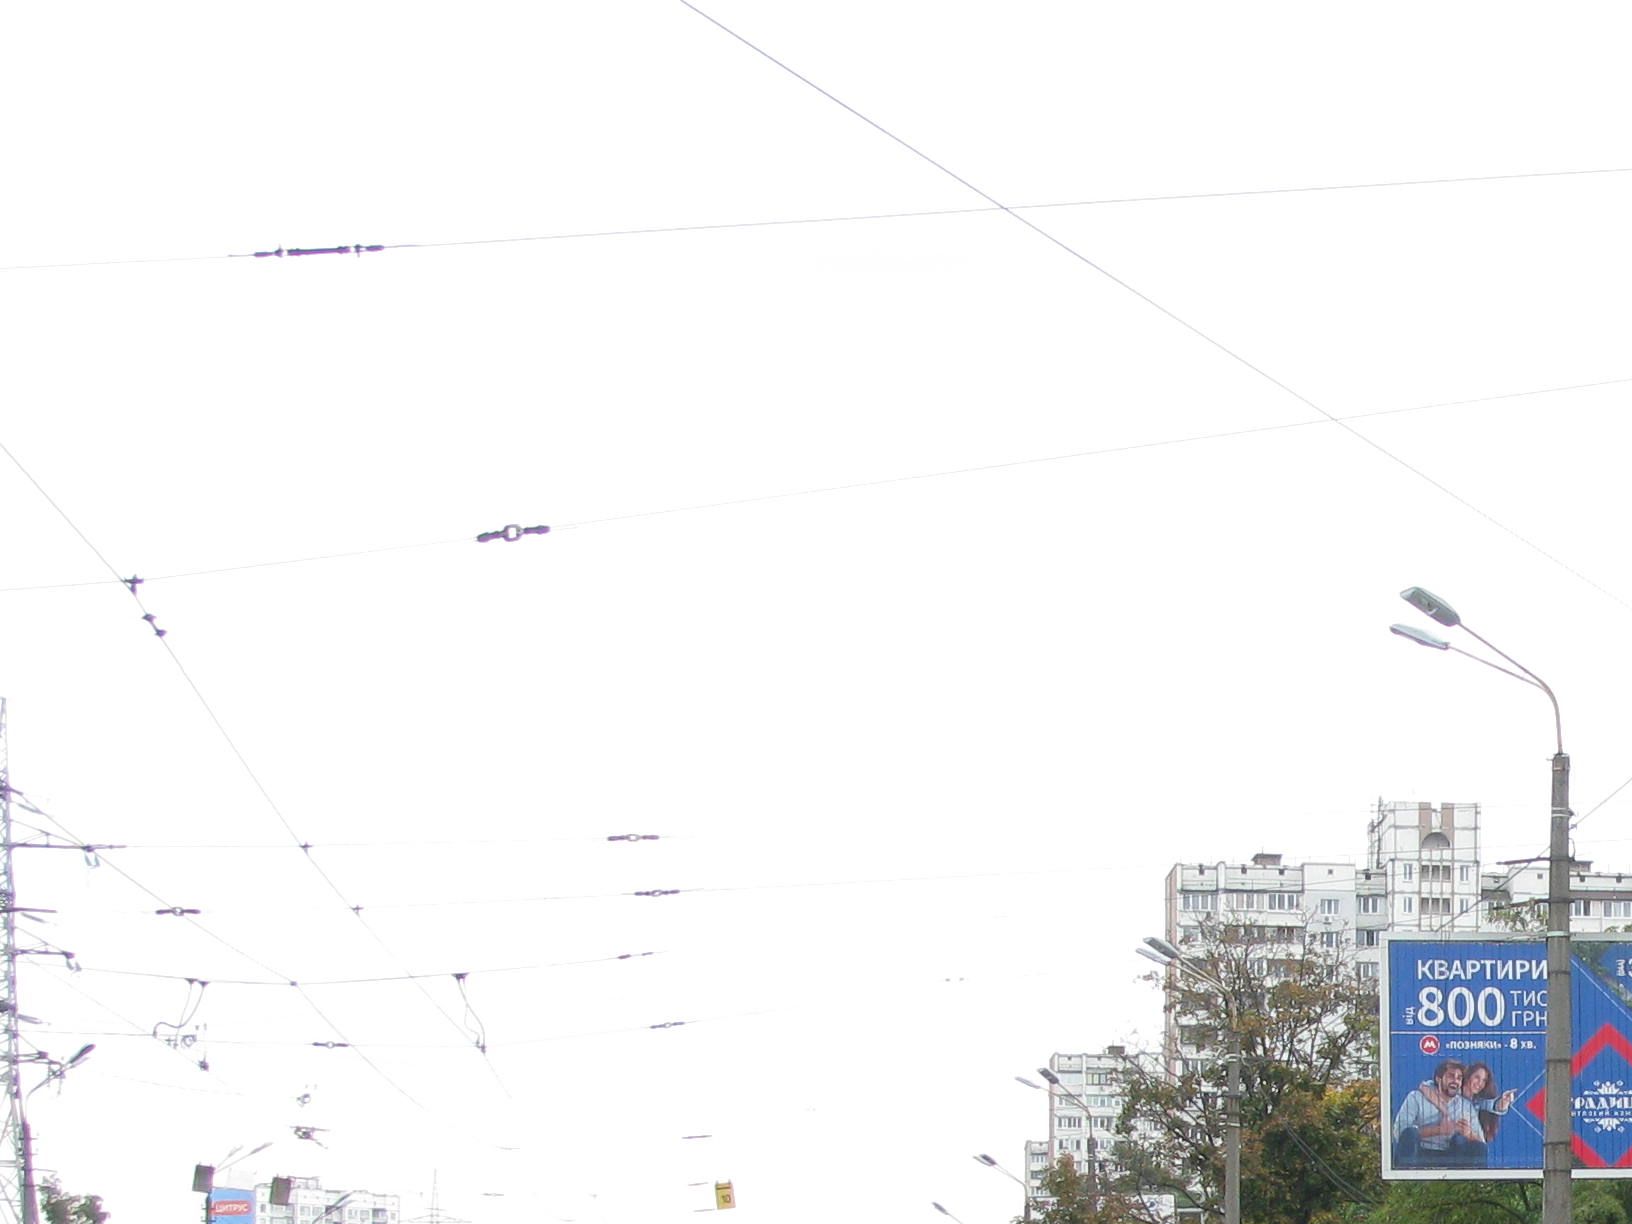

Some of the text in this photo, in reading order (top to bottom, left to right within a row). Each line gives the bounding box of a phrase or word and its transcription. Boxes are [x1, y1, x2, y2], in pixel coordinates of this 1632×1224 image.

[1417, 959, 1548, 980] КВАРТИРИ
[1417, 986, 1506, 1028] 800
[1511, 1010, 1547, 1027] ГРН
[1509, 1038, 1518, 1050] 8
